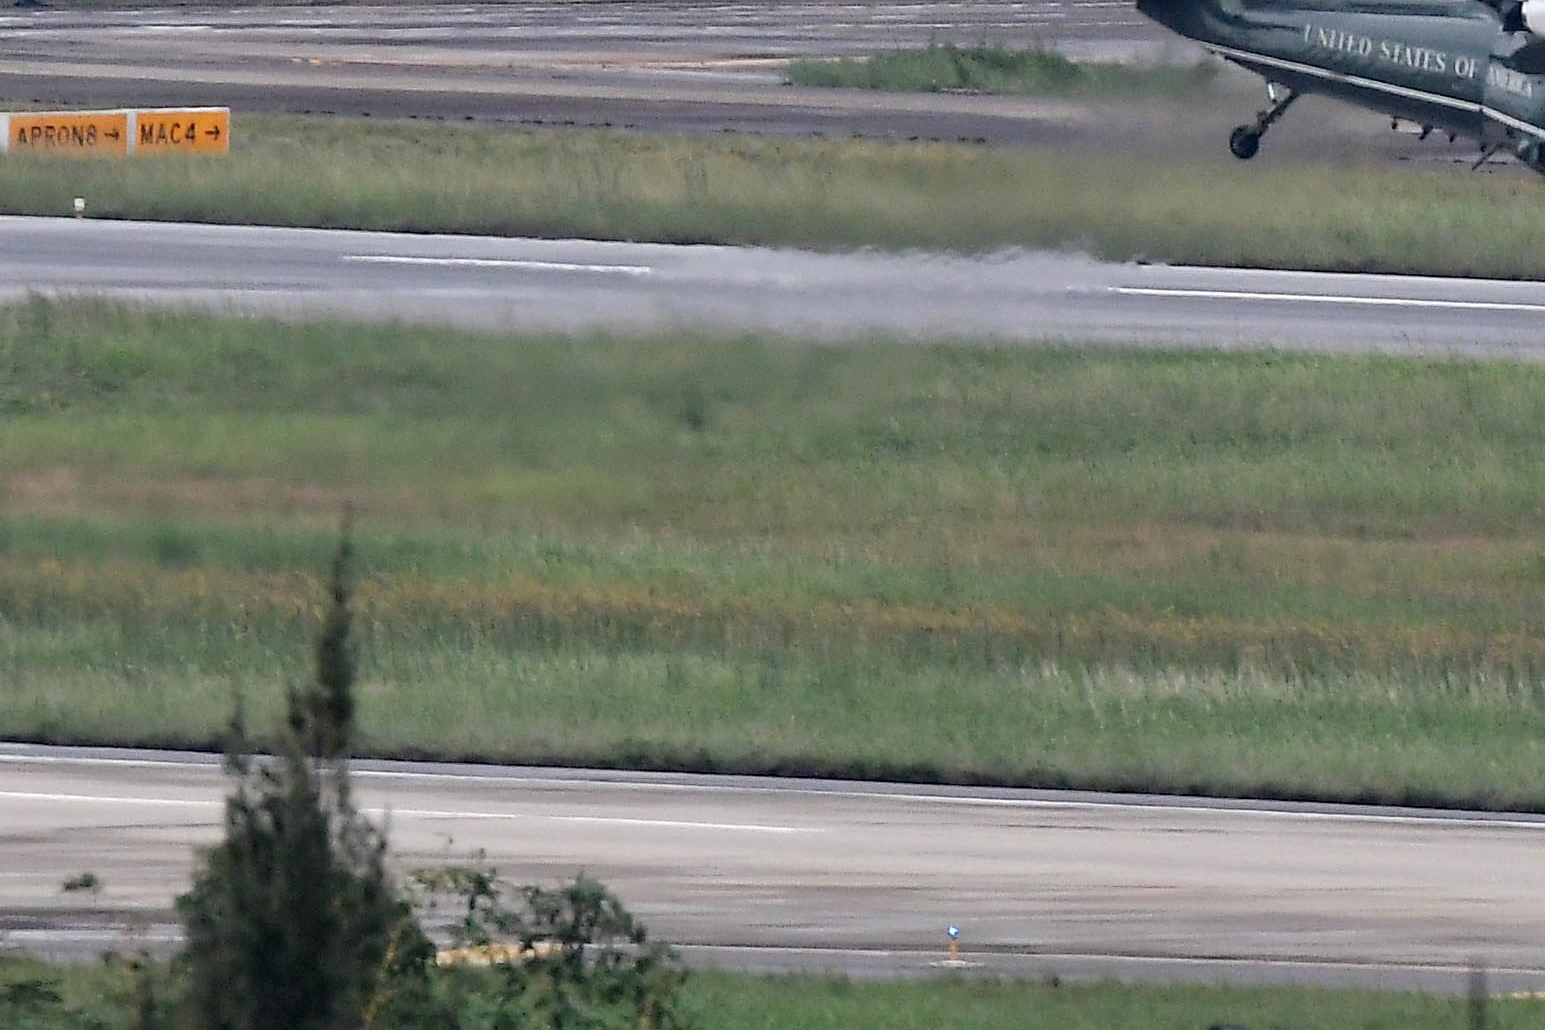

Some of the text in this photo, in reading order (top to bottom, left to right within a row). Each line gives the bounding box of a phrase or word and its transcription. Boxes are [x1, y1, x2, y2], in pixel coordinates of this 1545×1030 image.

[1303, 23, 1478, 79] UNITED STATES OF
[140, 122, 196, 146] MAC4
